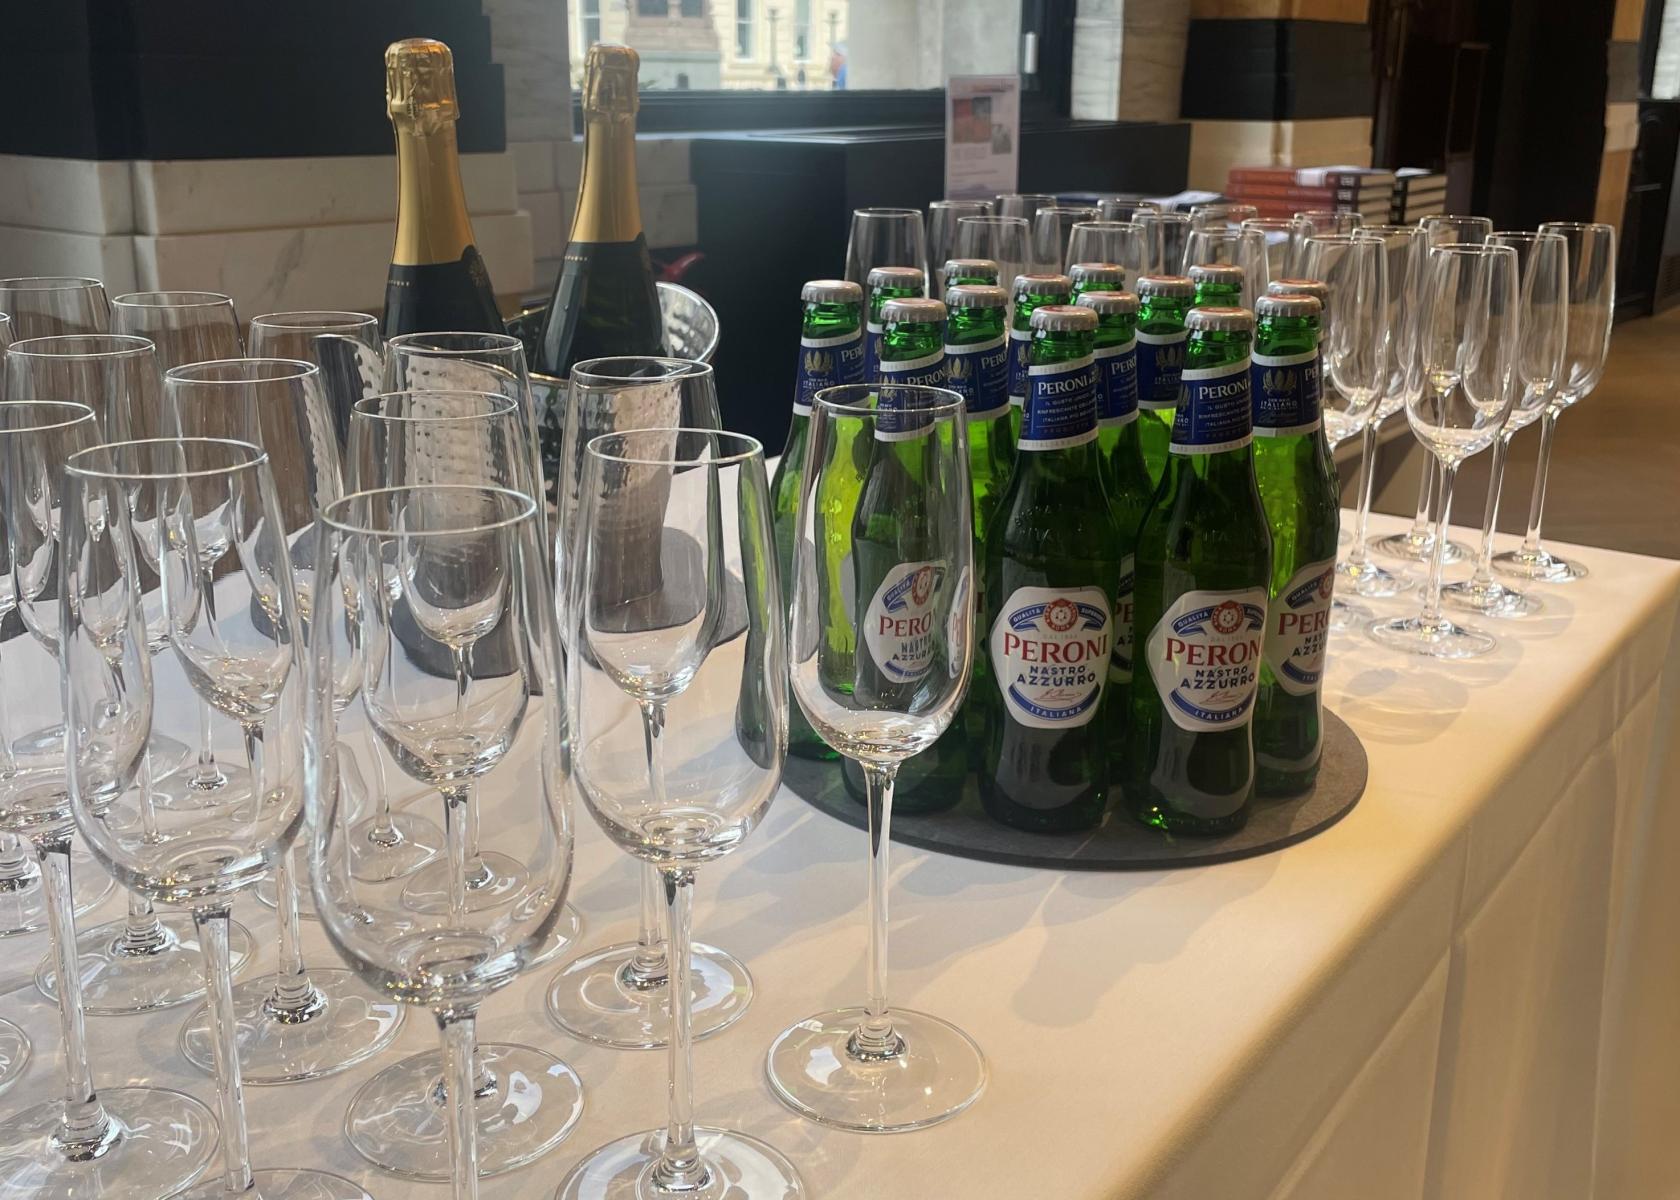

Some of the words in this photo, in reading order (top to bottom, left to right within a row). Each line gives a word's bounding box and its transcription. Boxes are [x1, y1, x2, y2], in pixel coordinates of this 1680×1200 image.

[981, 352, 1007, 369] PERO
[907, 367, 945, 386] PERON
[1038, 375, 1087, 395] PERONI
[1199, 379, 1248, 400] PERONI
[879, 611, 932, 637] PERO
[1003, 632, 1108, 663] PERONI
[1165, 638, 1260, 667] PERON
[1030, 665, 1086, 676] NASTRO
[1195, 665, 1248, 678] NASTRO
[1017, 673, 1096, 687] AZZURRO
[1180, 673, 1255, 689] AZZURRO
[1030, 706, 1082, 719] ITALIANA
[1195, 707, 1243, 720] ITALIANA
